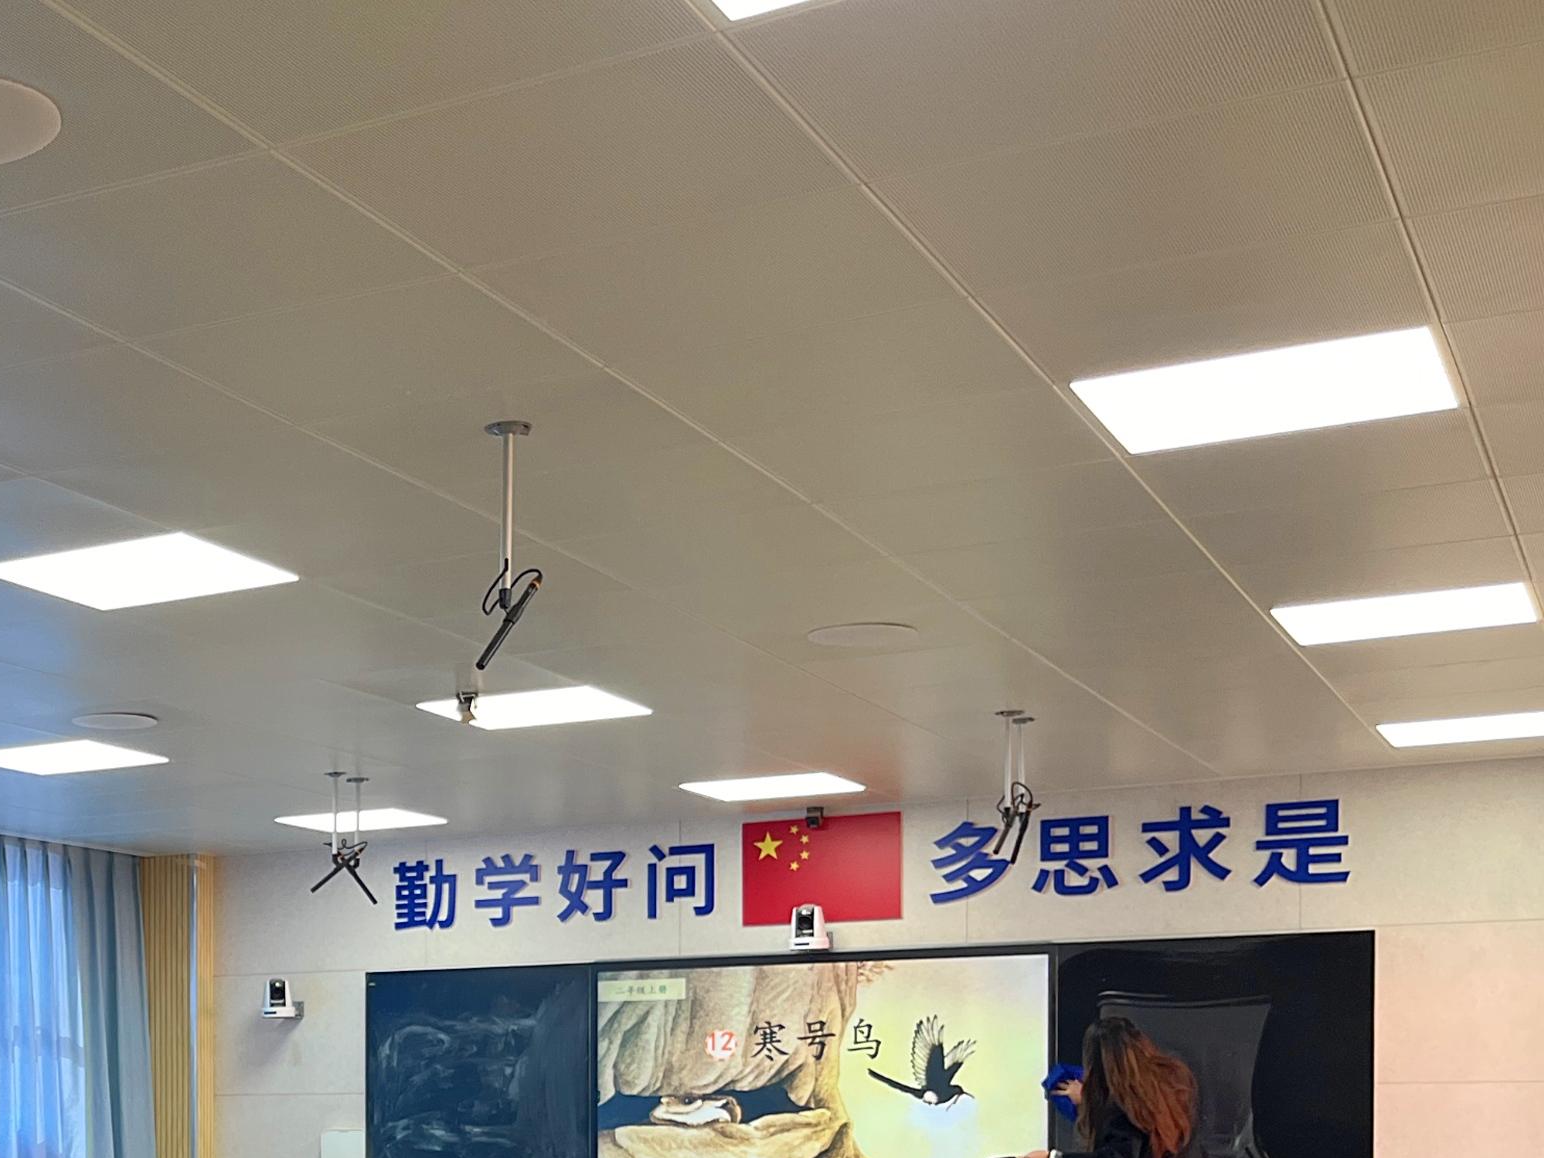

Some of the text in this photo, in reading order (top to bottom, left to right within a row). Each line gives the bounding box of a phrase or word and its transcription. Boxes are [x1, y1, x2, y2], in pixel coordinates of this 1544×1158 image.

[393, 843, 715, 931] 勤学好问
[930, 799, 1351, 904] 多思求是
[710, 1018, 882, 1061] 12 寒号鸟
